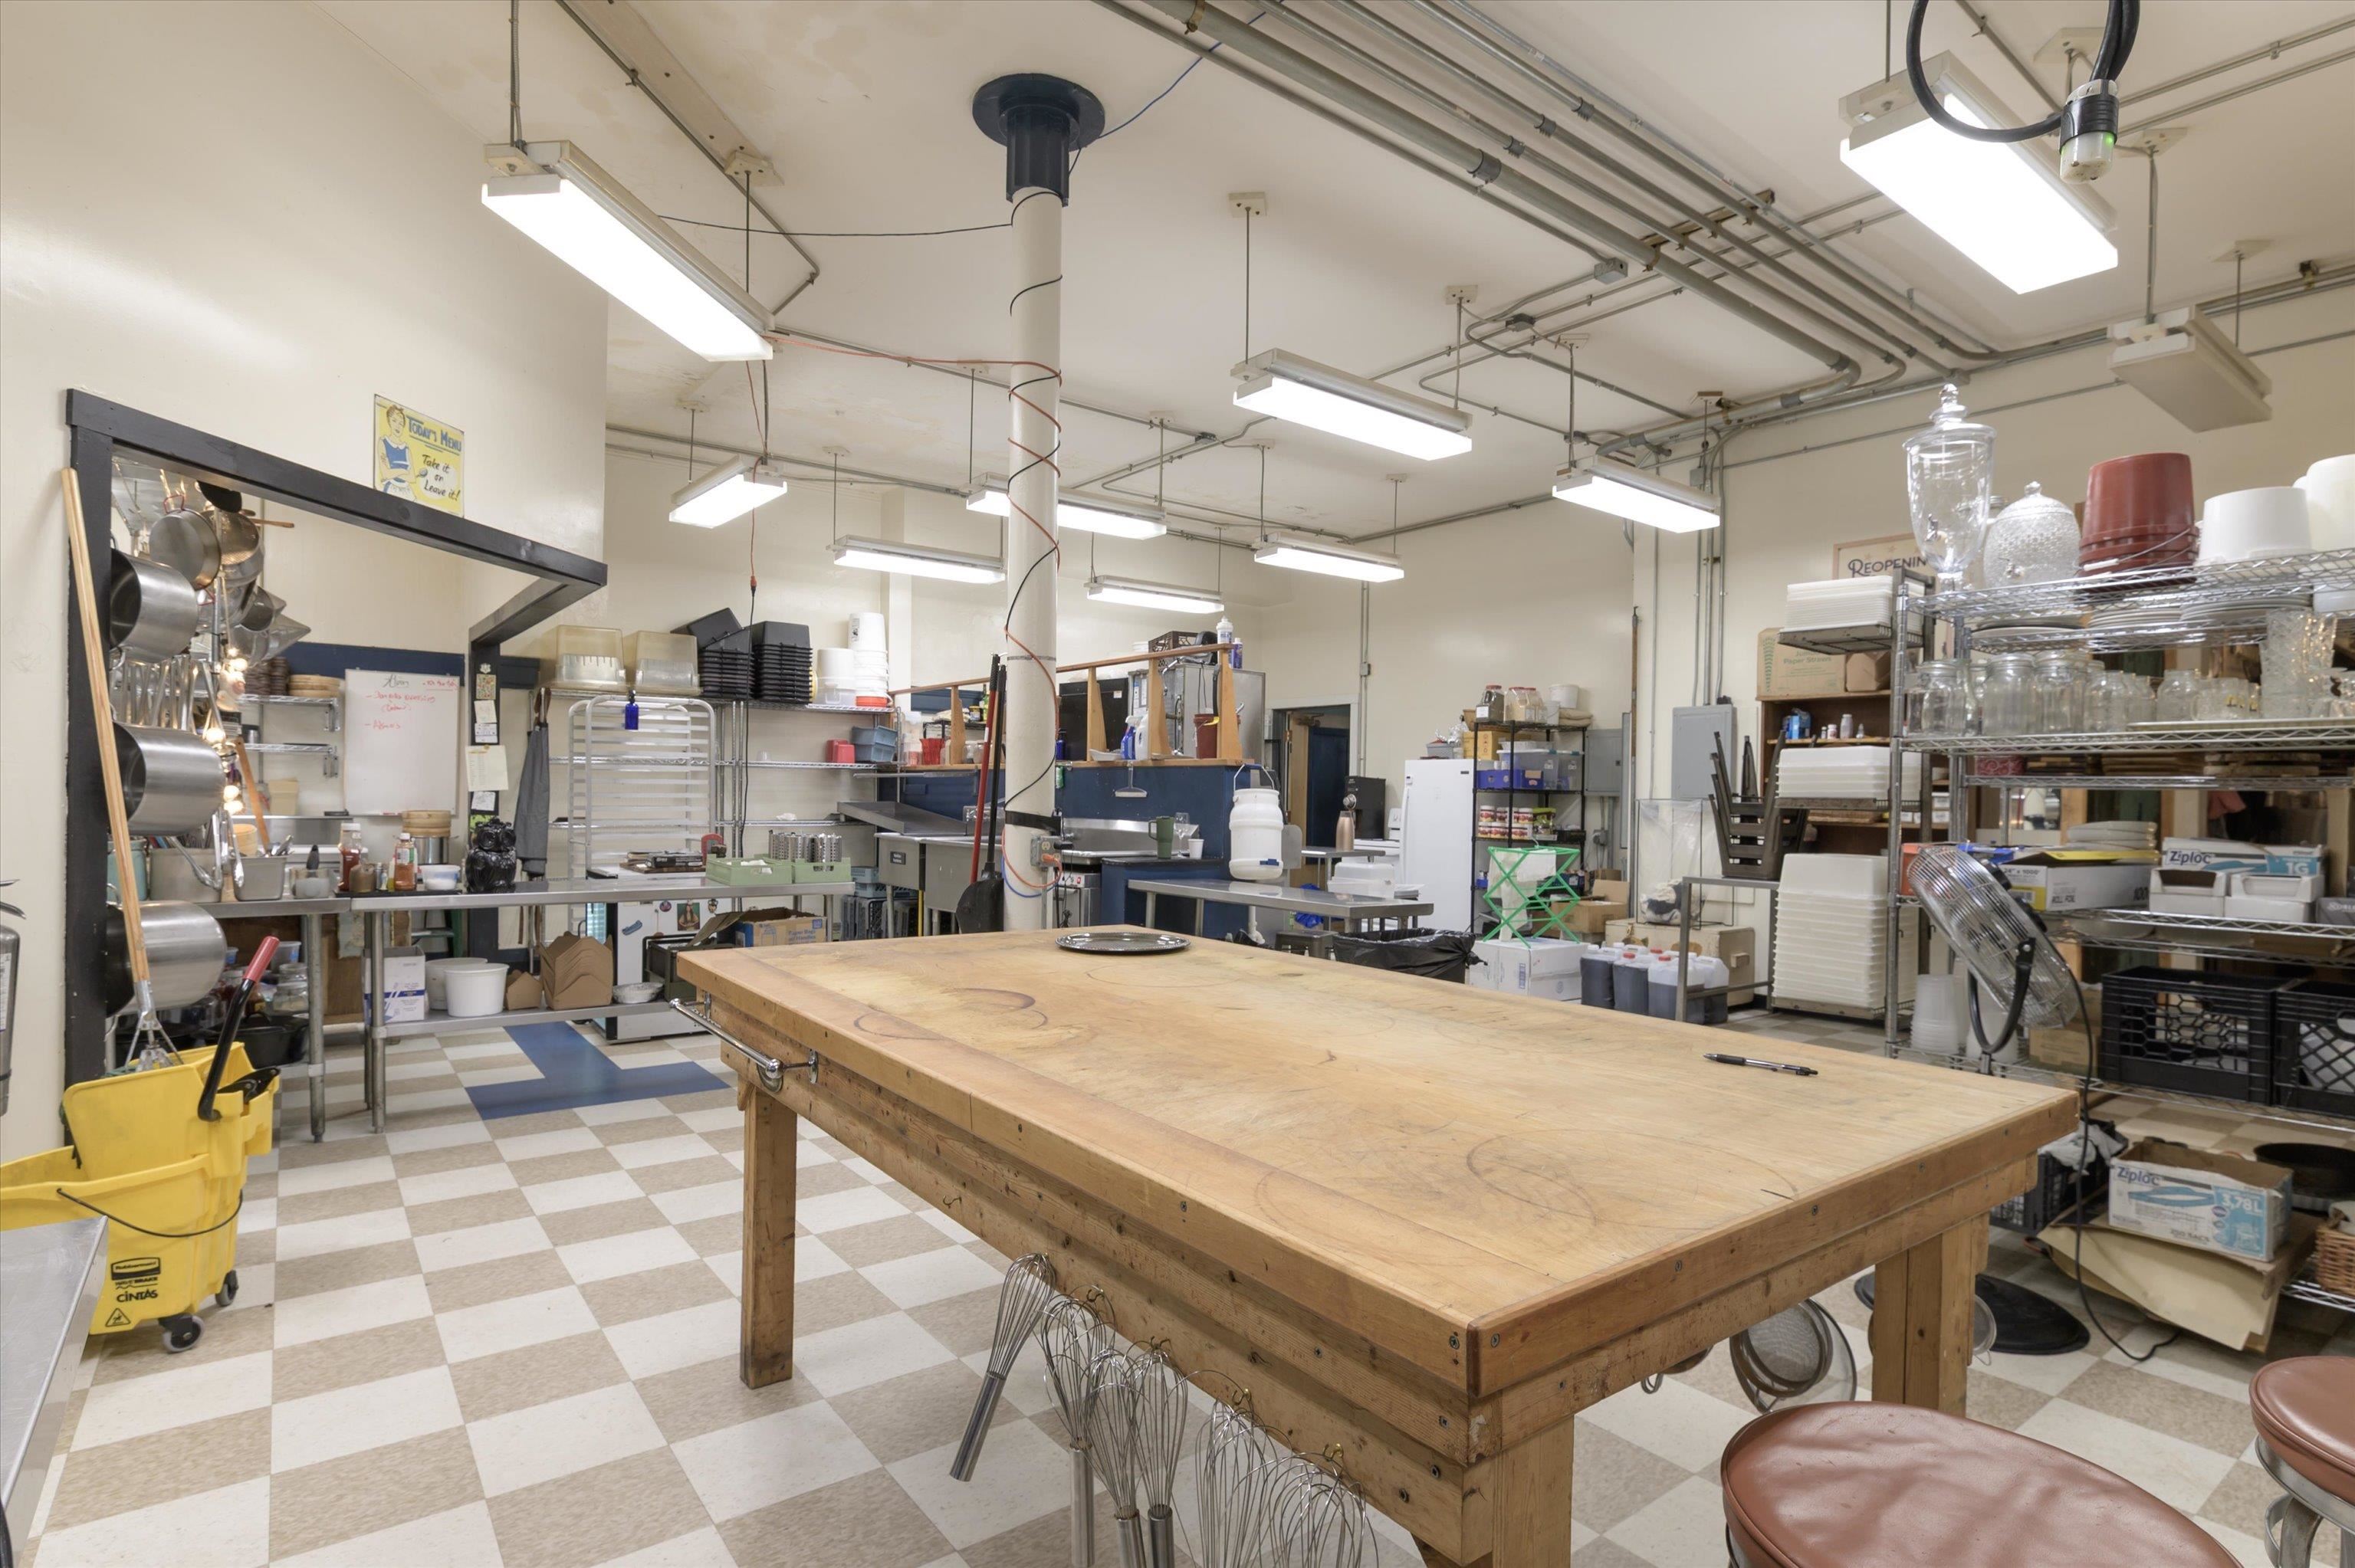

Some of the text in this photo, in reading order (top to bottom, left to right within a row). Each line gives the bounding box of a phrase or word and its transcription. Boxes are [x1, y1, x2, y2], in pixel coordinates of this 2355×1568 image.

[440, 429, 461, 452] MENU
[422, 454, 451, 474] Take it
[424, 479, 461, 501] Leave it!
[1848, 556, 1929, 579] REOPENIN
[2169, 851, 2211, 866] Ziploc
[2117, 1166, 2161, 1186] Ziploc
[117, 1288, 158, 1303] CINTAS
